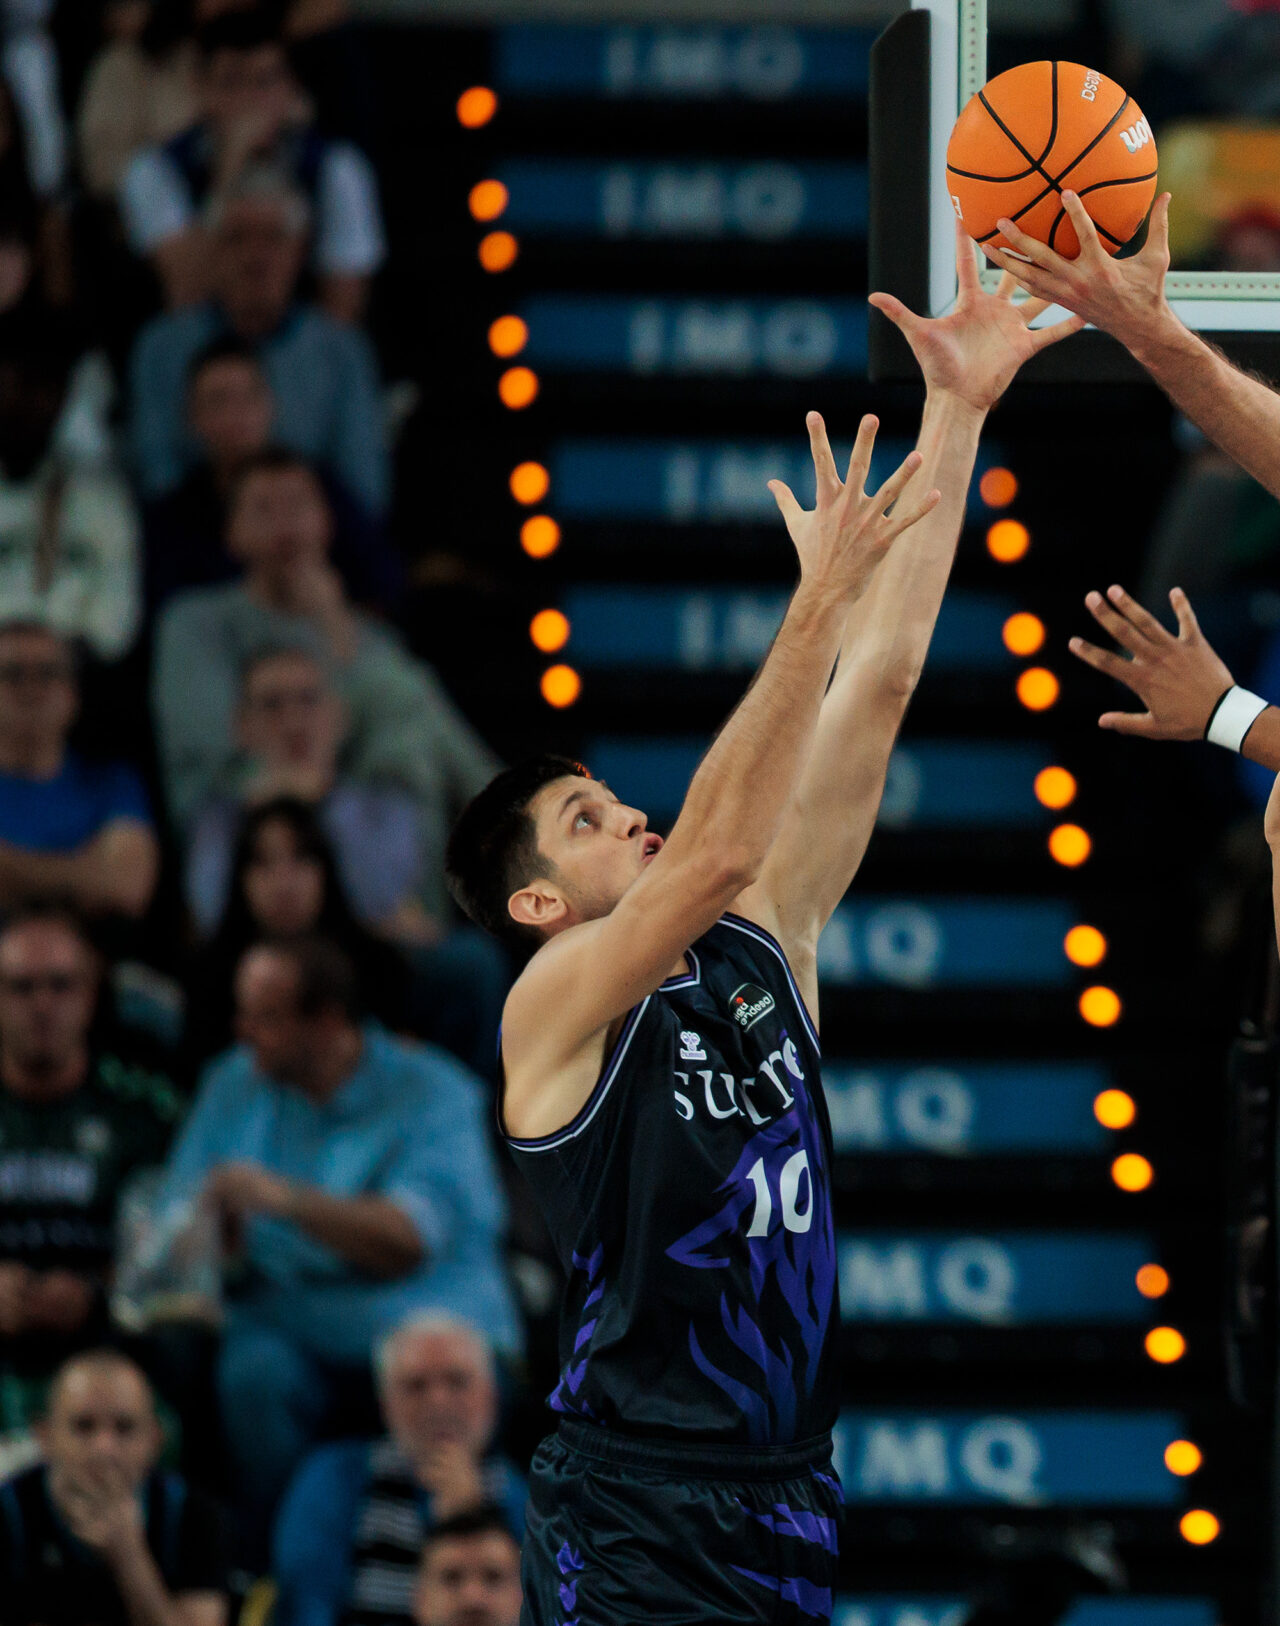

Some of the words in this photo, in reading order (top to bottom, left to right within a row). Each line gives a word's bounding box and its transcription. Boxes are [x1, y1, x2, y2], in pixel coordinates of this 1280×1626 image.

[740, 996, 771, 1025] endesa
[745, 1149, 814, 1237] 10
[840, 1235, 1015, 1326] MQ
